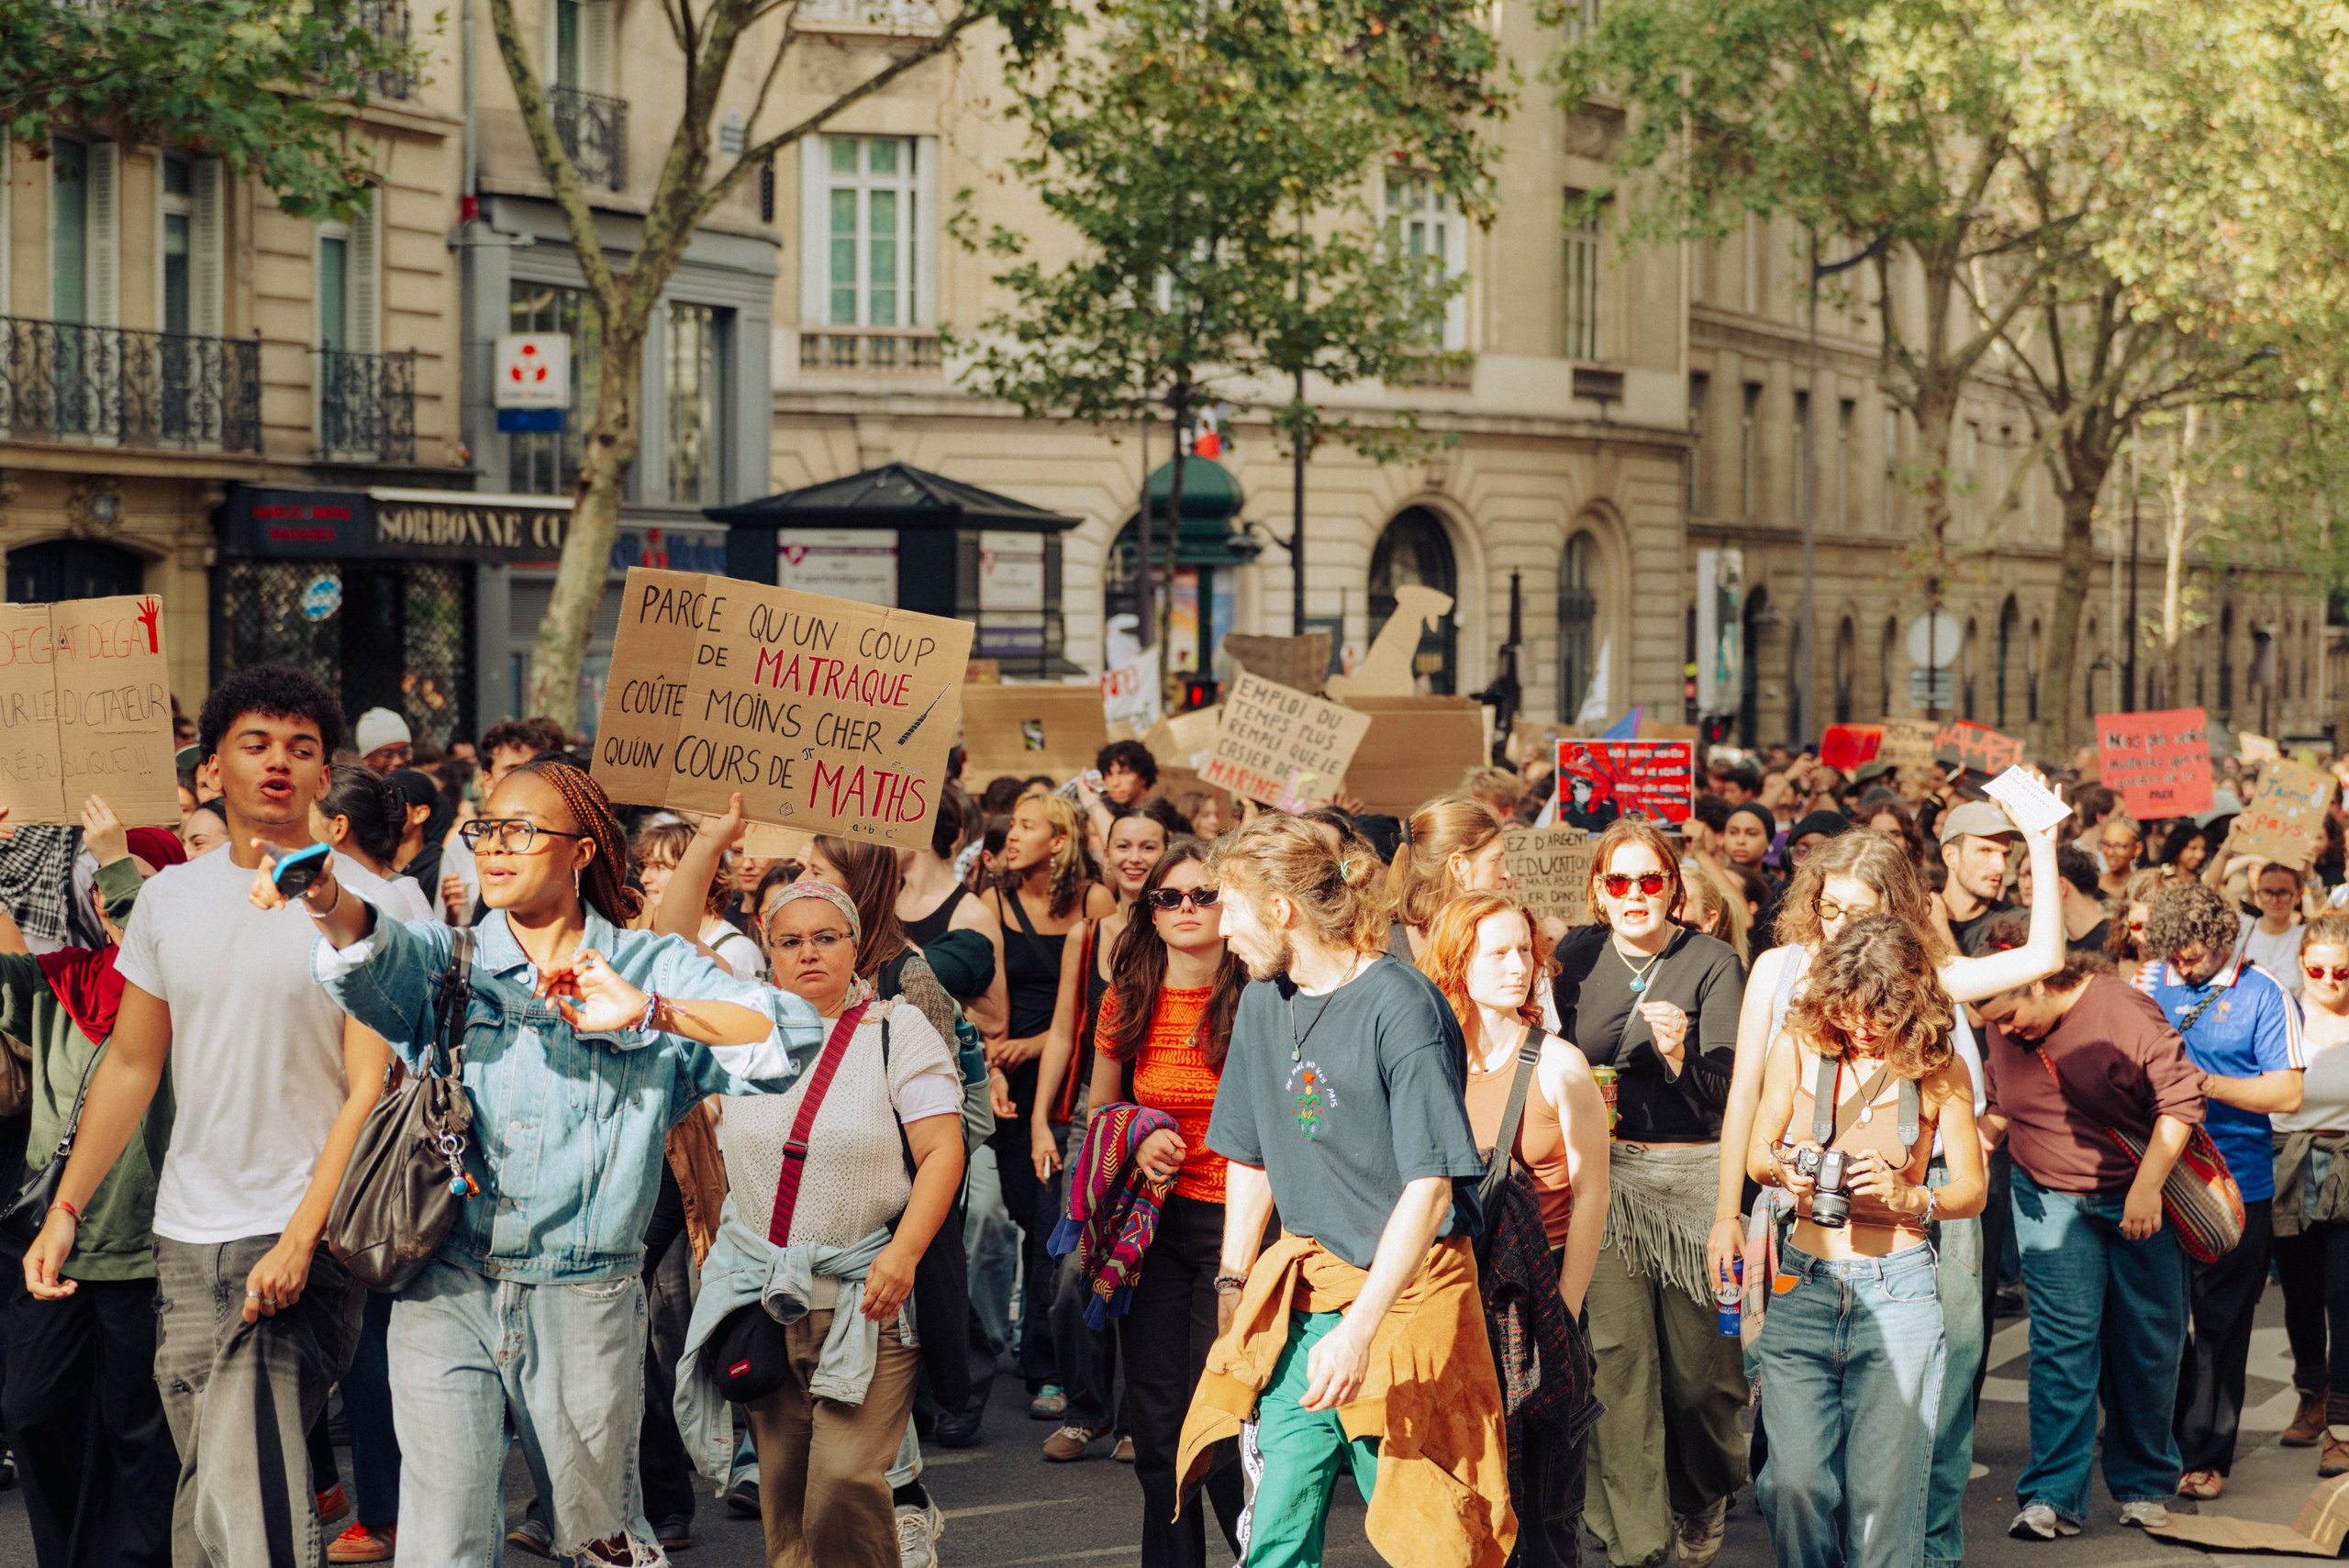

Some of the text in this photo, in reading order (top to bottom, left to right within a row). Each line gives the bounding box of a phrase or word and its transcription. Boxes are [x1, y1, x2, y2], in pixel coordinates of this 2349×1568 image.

[377, 507, 522, 549] SORBONNE
[532, 511, 572, 550] CU
[640, 584, 936, 667] PARCE QU'UN COUP
[697, 644, 914, 709] DE MATRAQUE
[0, 683, 168, 728] UR LE DICTATEUR
[621, 674, 883, 754] COÛTE MOINS CHER
[1234, 698, 1337, 751] TEMPS PLUS
[1238, 678, 1343, 729] EMPLOI DU
[0, 746, 128, 782] RÉPUBLIQUE
[1217, 738, 1273, 770] CASIER
[1228, 717, 1341, 775] REMPLI QUE LE
[604, 735, 927, 825] QU'UN COURS DE MATHS
[1205, 758, 1282, 802] MARINE
[1535, 832, 1588, 851] D'ARGENT
[1525, 876, 1552, 888] MAIS
[1553, 875, 1584, 887] ASSEZ
[1550, 890, 1576, 903] DANS
[1306, 1060, 1316, 1069] NO
[1326, 1088, 1339, 1108] PAIS
